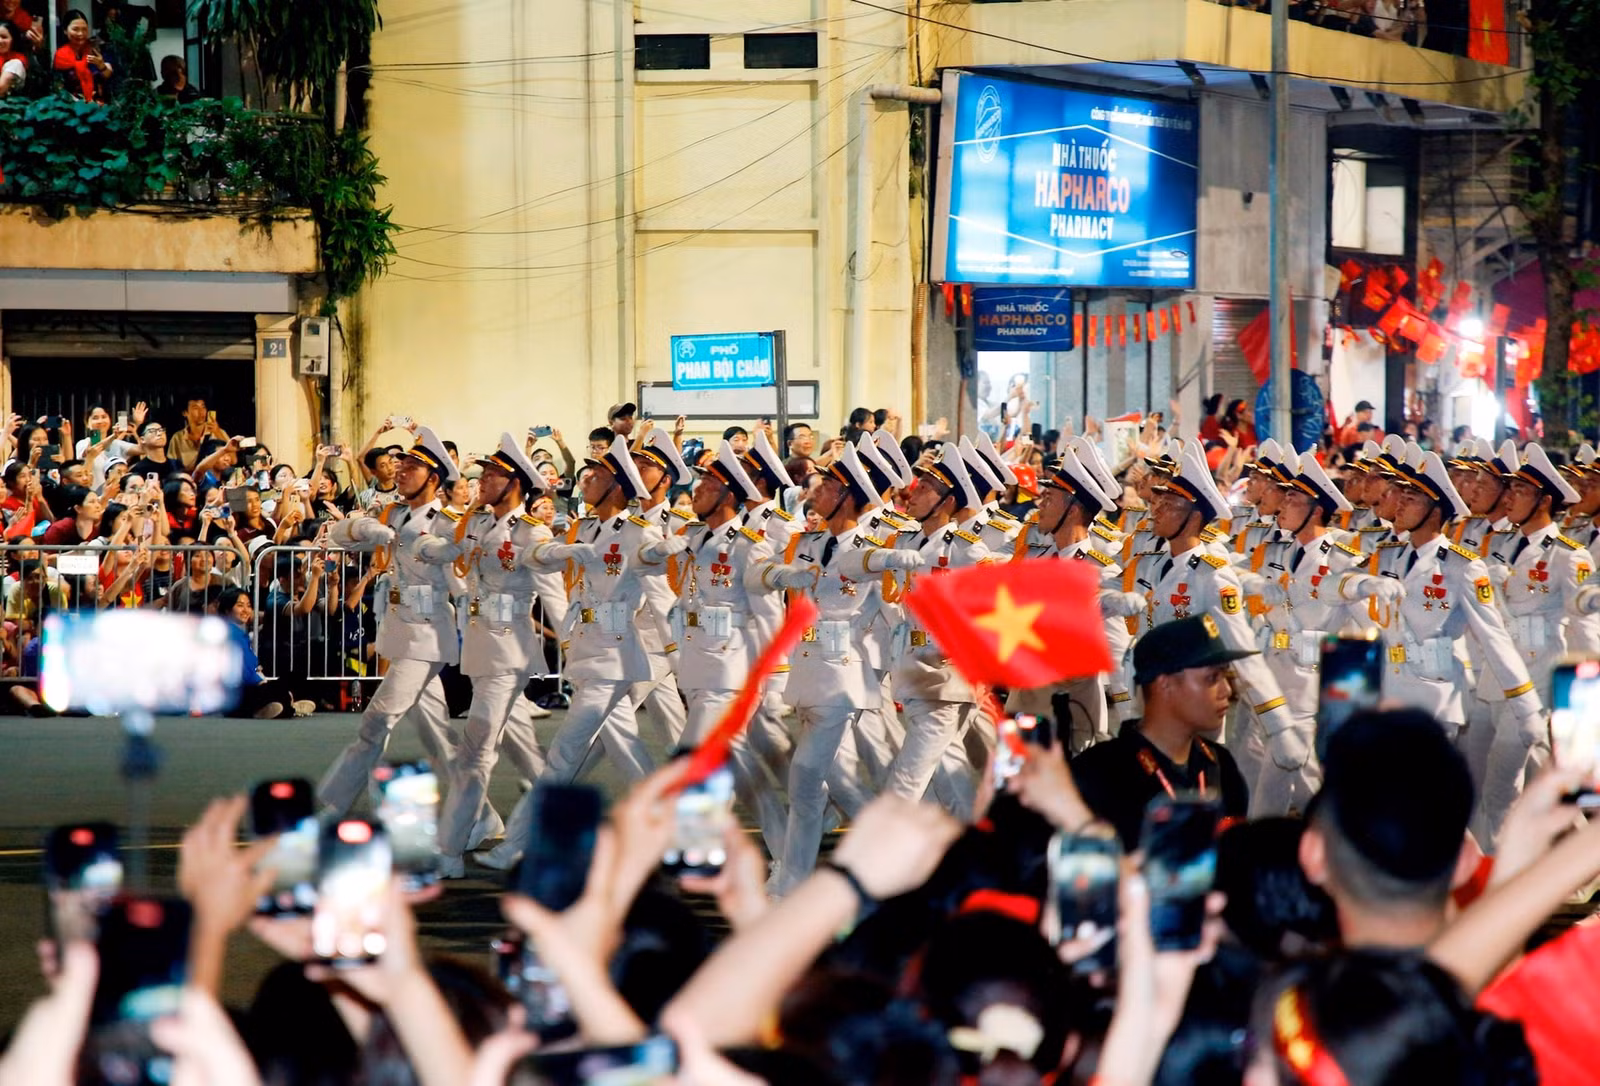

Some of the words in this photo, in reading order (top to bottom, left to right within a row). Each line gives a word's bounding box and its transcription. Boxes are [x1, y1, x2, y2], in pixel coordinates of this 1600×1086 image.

[1053, 138, 1077, 169] NHÀ
[1079, 138, 1117, 172] THUỐC
[1035, 171, 1130, 214] HAPHARCO
[1050, 213, 1114, 240] PHARMACY
[996, 303, 1016, 312] NHÀ
[979, 314, 1067, 326] HAPHARCO
[997, 328, 1048, 336] PHARMACY
[710, 342, 739, 355] PHỐ
[677, 361, 711, 380] PHAN
[713, 357, 734, 382] BỘI
[736, 356, 769, 378] CHÂU
